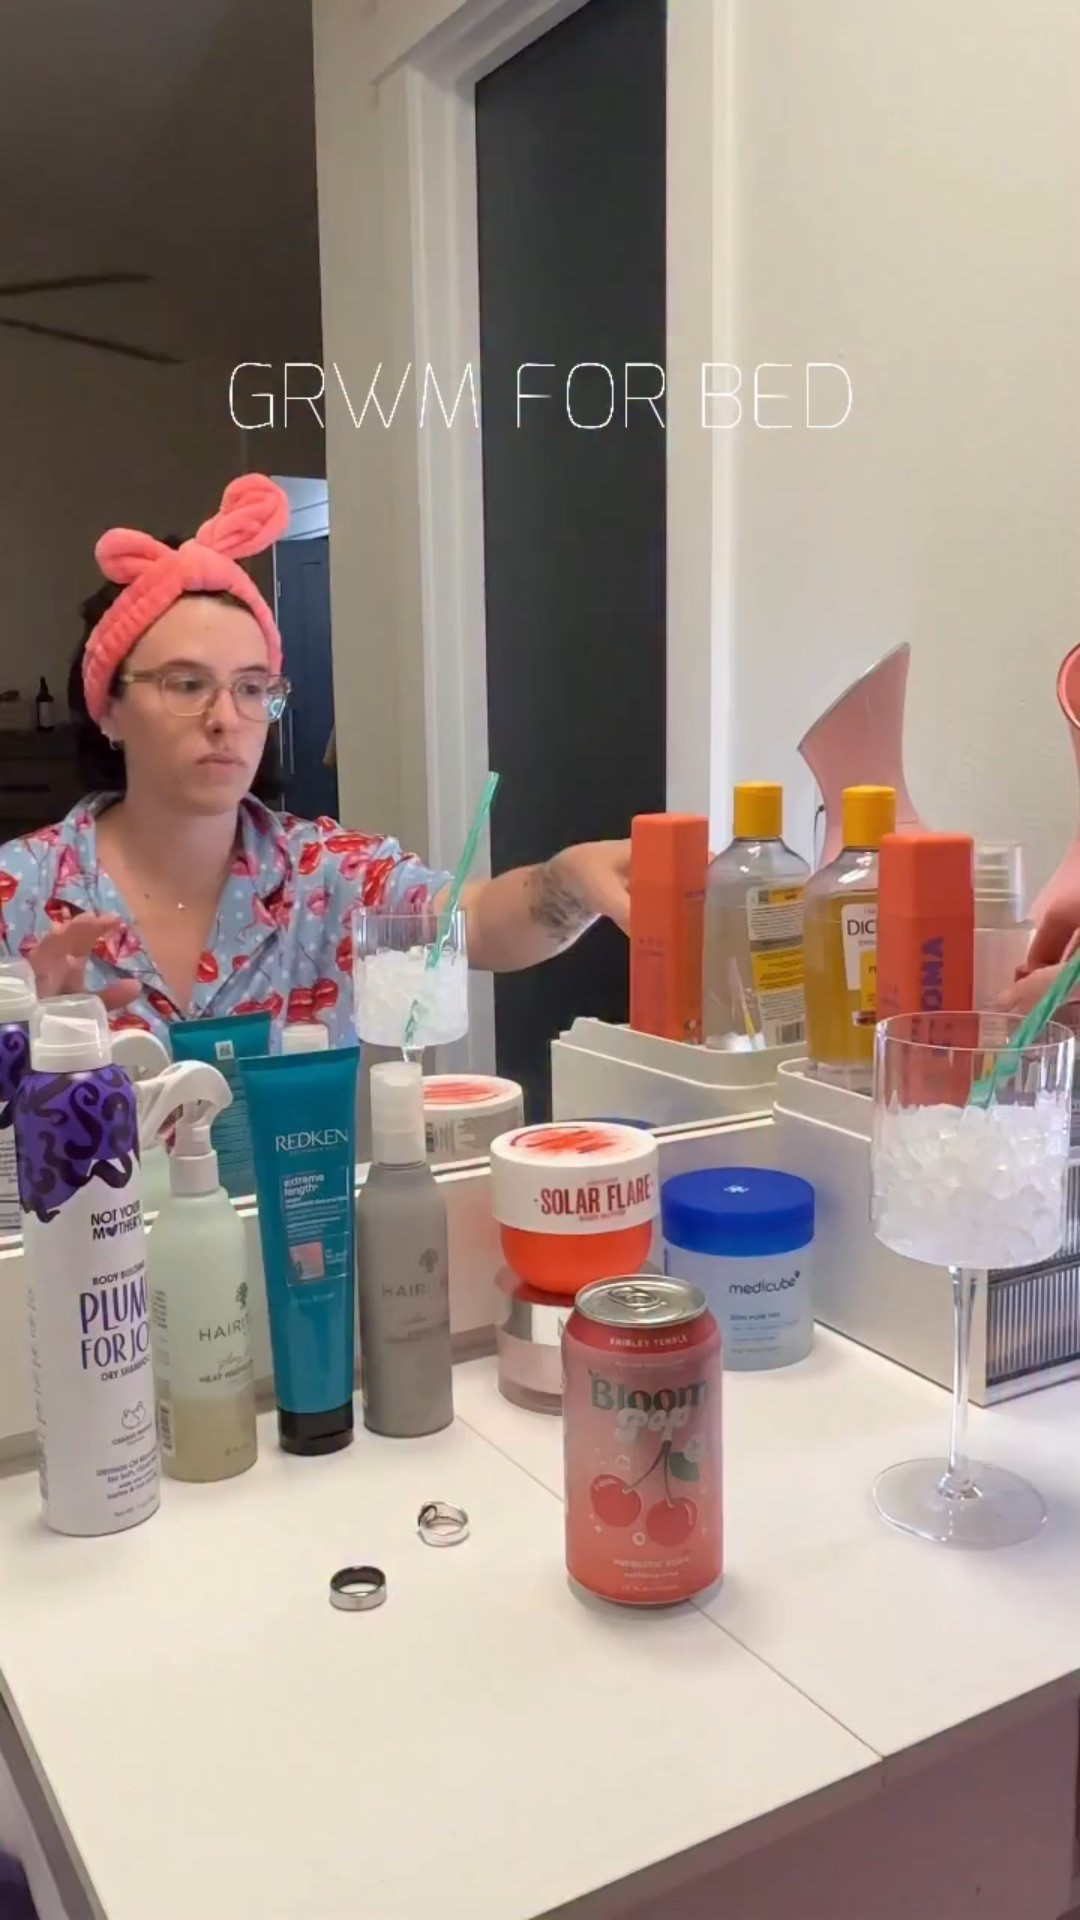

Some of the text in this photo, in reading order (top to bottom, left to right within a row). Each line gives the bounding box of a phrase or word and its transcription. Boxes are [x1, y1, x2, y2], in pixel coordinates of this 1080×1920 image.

[275, 1128, 349, 1151] REDKEN
[284, 1174, 324, 1187] extreme
[541, 1174, 651, 1214] SOLAR FLARE
[91, 1209, 117, 1226] NOT
[93, 1272, 119, 1286] BODY
[729, 1276, 797, 1295] medicube
[79, 1275, 148, 1334] PLUM
[653, 1334, 688, 1346] TEMPLE
[81, 1333, 126, 1370] FOR
[591, 1378, 708, 1412] Bloom
